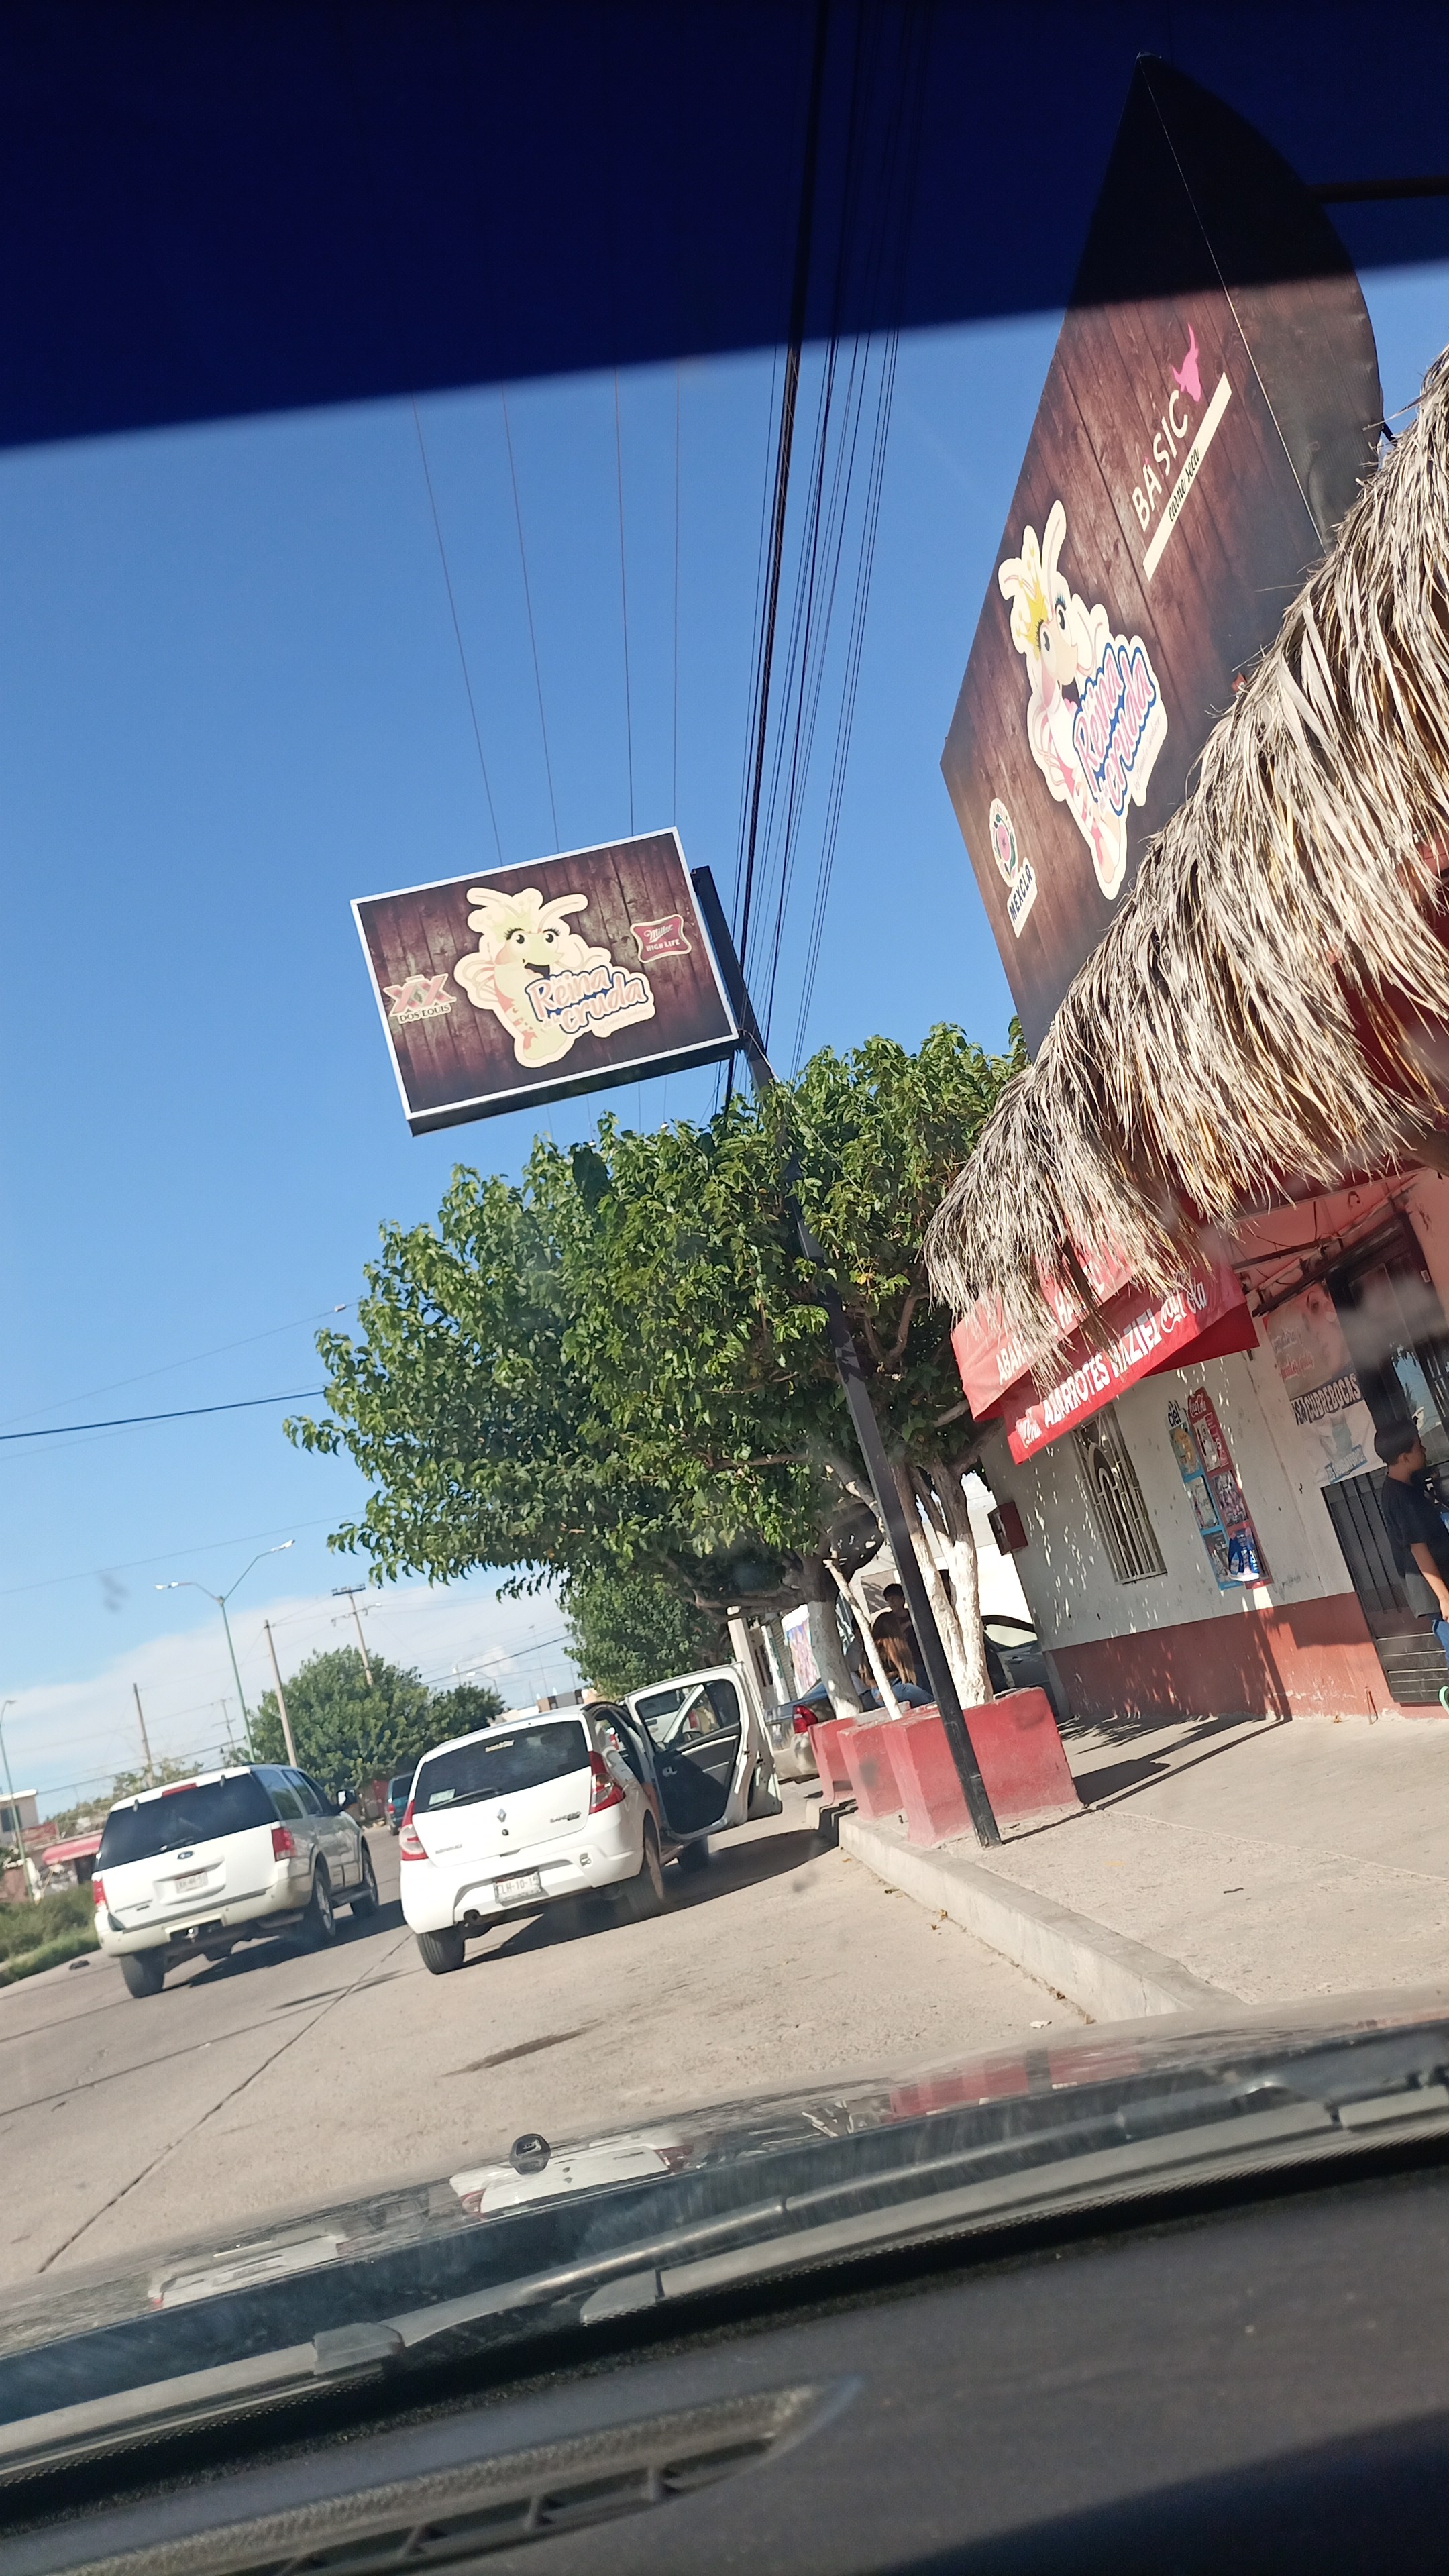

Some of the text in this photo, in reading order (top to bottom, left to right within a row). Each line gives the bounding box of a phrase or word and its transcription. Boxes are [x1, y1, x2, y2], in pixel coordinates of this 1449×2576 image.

[1169, 447, 1200, 522] carne seca
[1074, 651, 1122, 794] Reina
[1106, 655, 1152, 807] cruda
[1008, 863, 1033, 924] MEXCLA
[644, 924, 673, 943] Miller
[645, 938, 680, 952] HIGH LIFE
[399, 1004, 450, 1022] DOS EQUIS
[529, 968, 611, 1019] Reina
[562, 974, 645, 1031] cruda
[1044, 1352, 1111, 1428] ABARROTES
[1168, 1405, 1182, 1427] ciel
[1302, 1372, 1362, 1419] CUBREBOCAS
